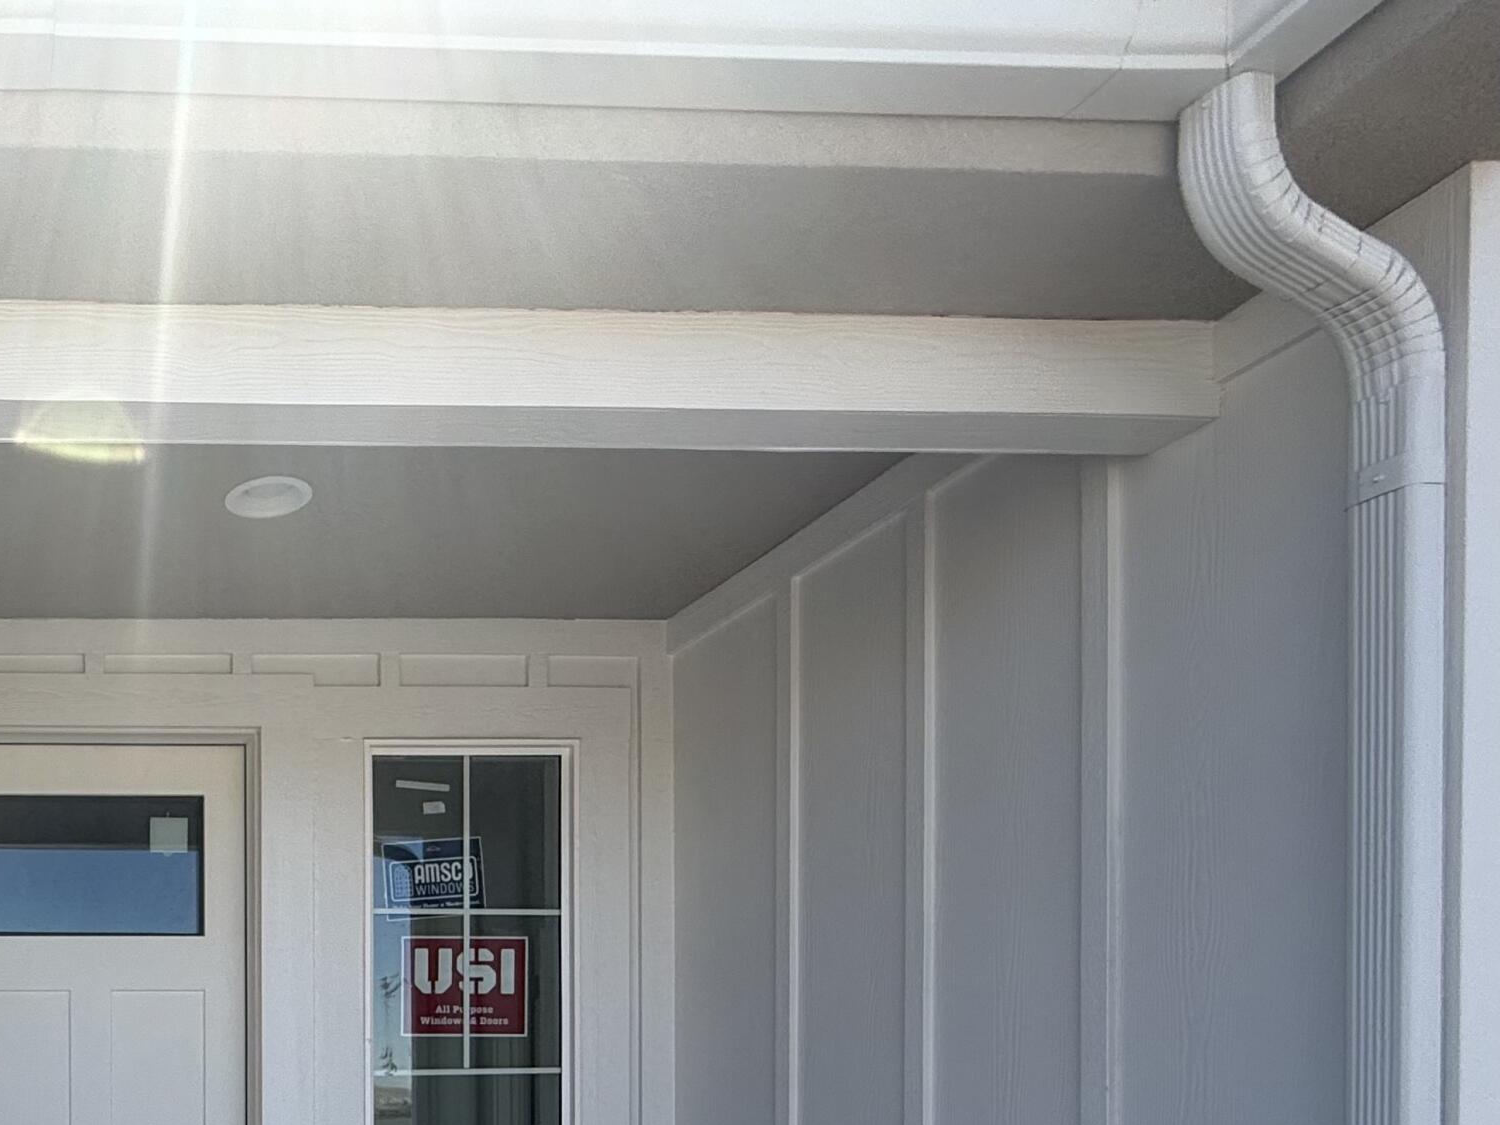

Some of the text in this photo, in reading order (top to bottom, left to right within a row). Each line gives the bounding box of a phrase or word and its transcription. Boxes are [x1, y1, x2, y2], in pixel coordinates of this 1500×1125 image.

[414, 948, 515, 994] USI
[435, 1005, 450, 1014] All
[420, 1016, 465, 1025] Window
[480, 1016, 509, 1025] Doors
